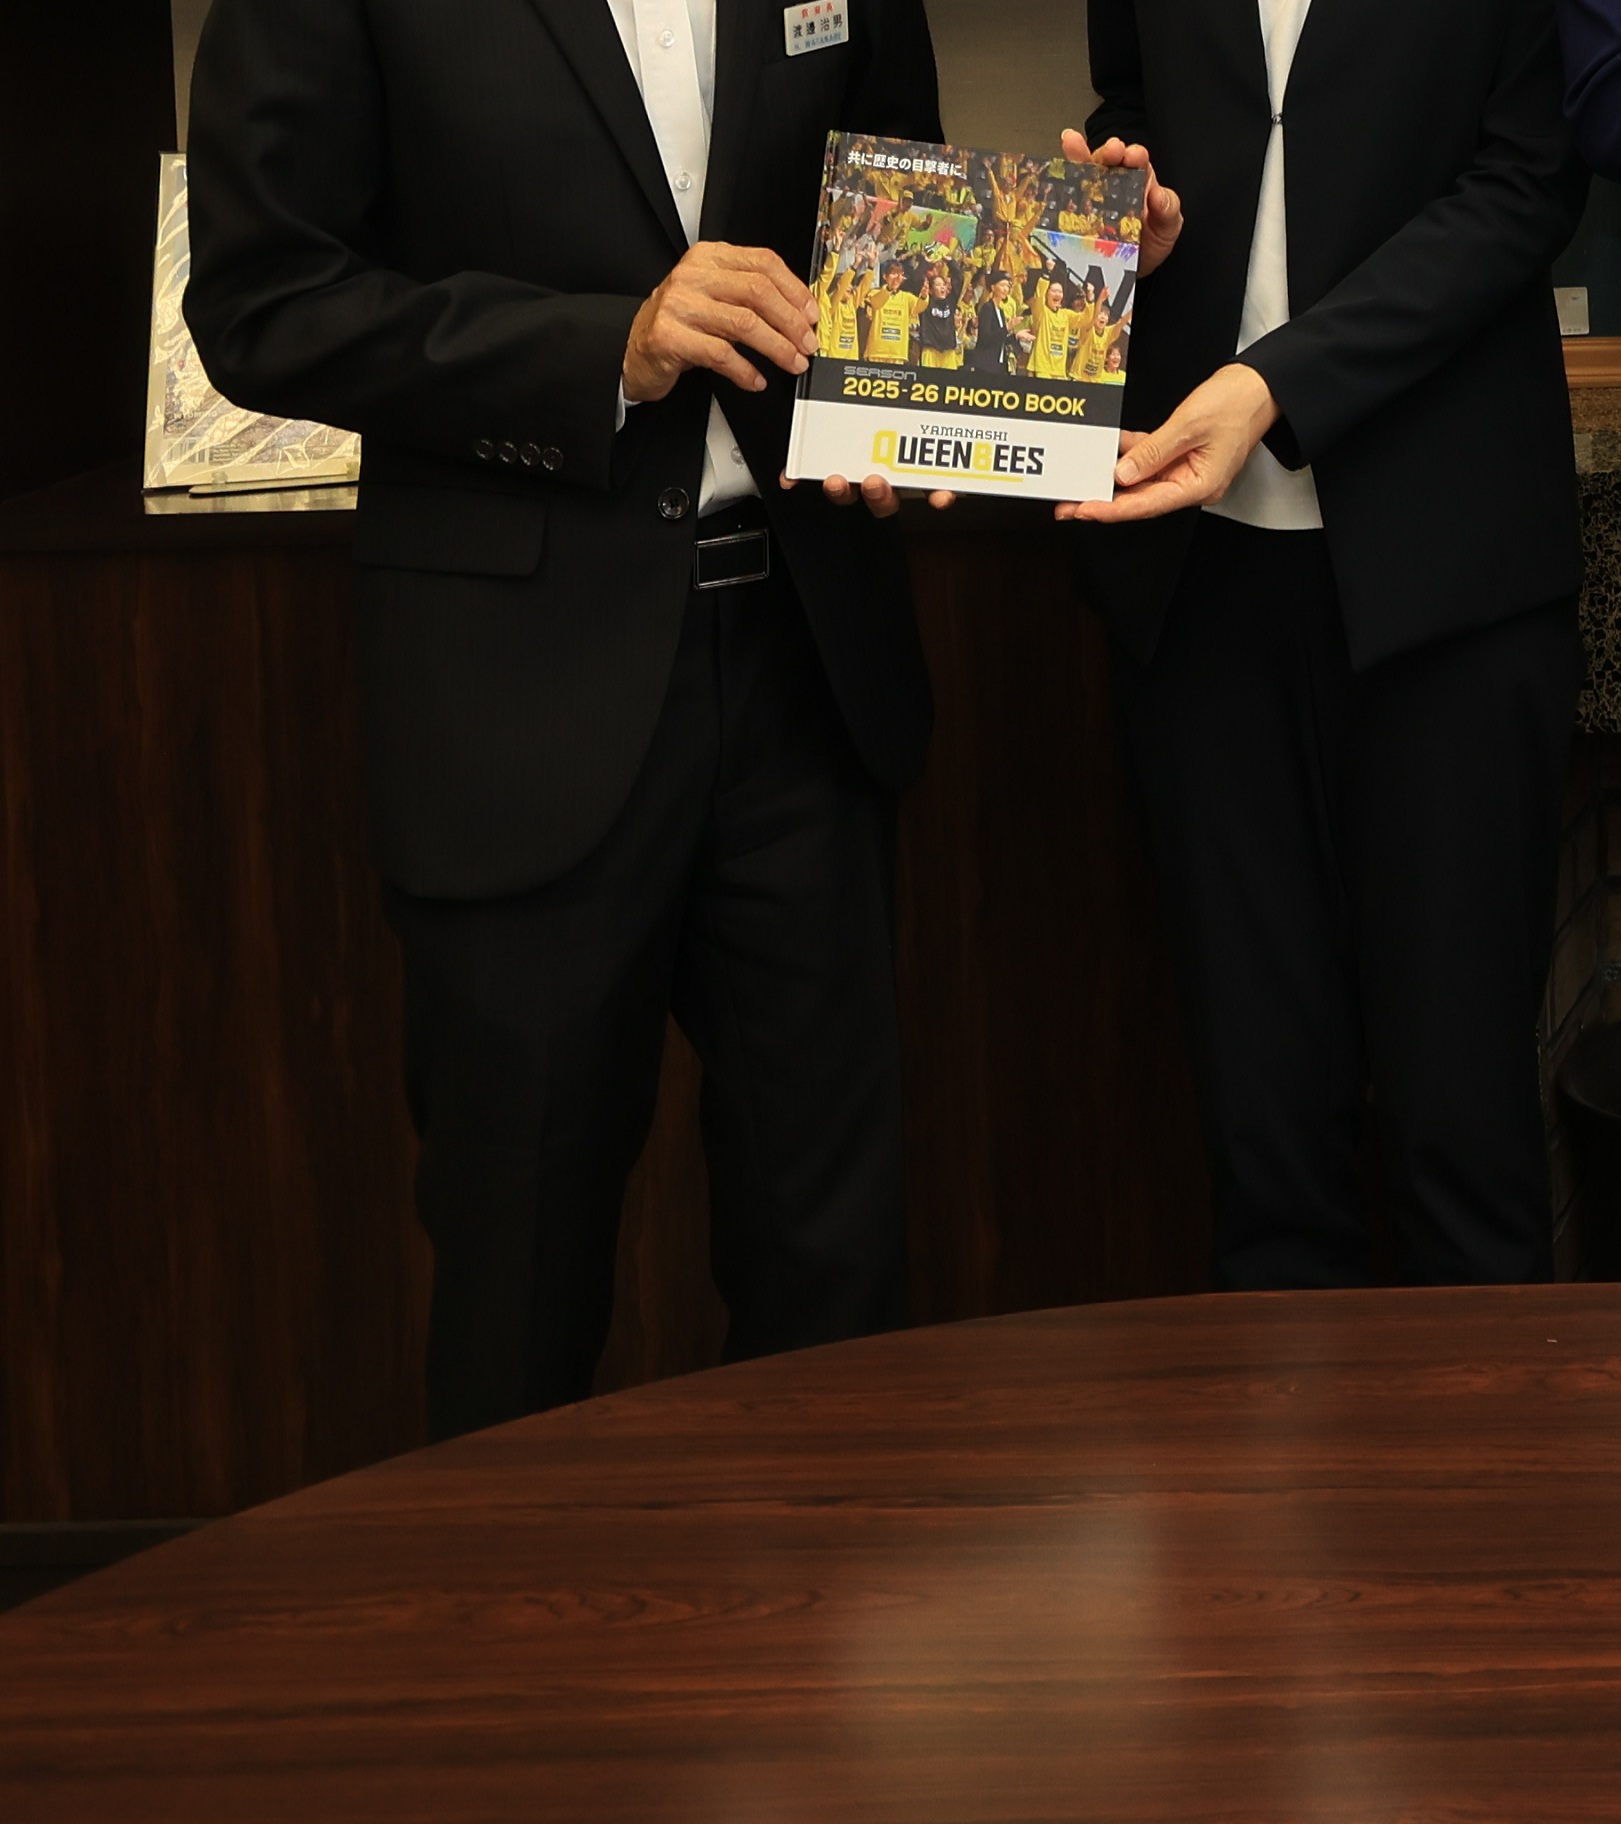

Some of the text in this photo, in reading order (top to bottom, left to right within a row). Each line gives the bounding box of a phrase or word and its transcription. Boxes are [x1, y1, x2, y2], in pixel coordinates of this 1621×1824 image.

[944, 389, 1020, 412] PHOTO
[1024, 394, 1087, 417] BOOK
[919, 424, 1008, 442] YAMANASHI
[872, 429, 1045, 479] QUEENBEES
